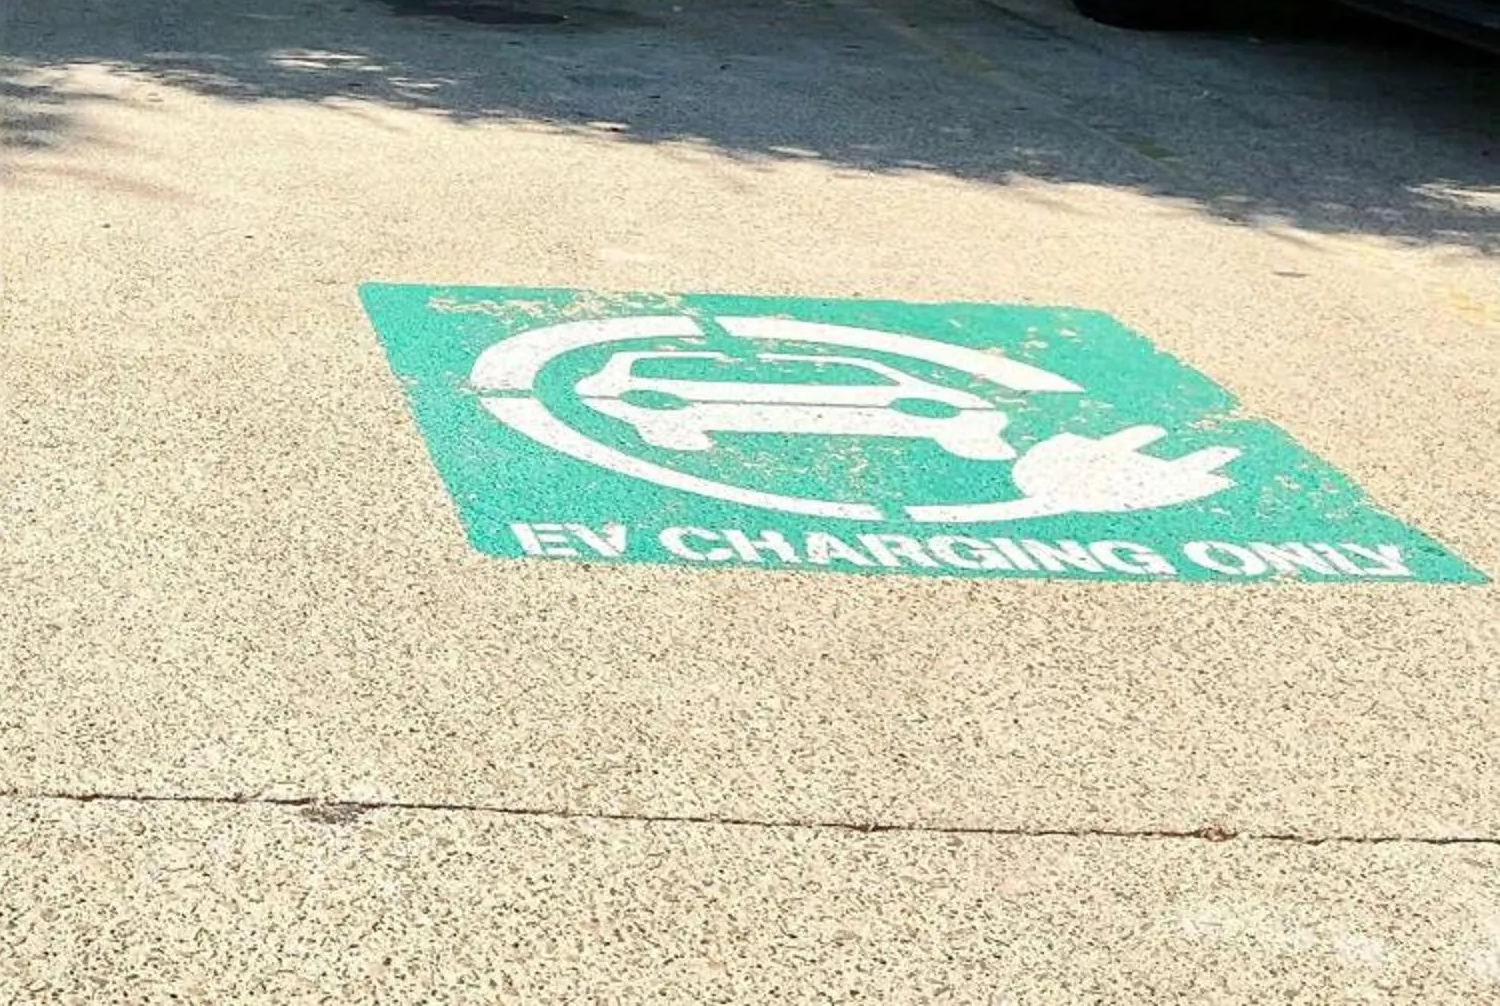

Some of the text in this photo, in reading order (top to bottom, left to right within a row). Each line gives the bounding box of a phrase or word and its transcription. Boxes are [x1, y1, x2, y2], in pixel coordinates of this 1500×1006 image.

[509, 522, 1412, 577] EV CHARGING ONLY
